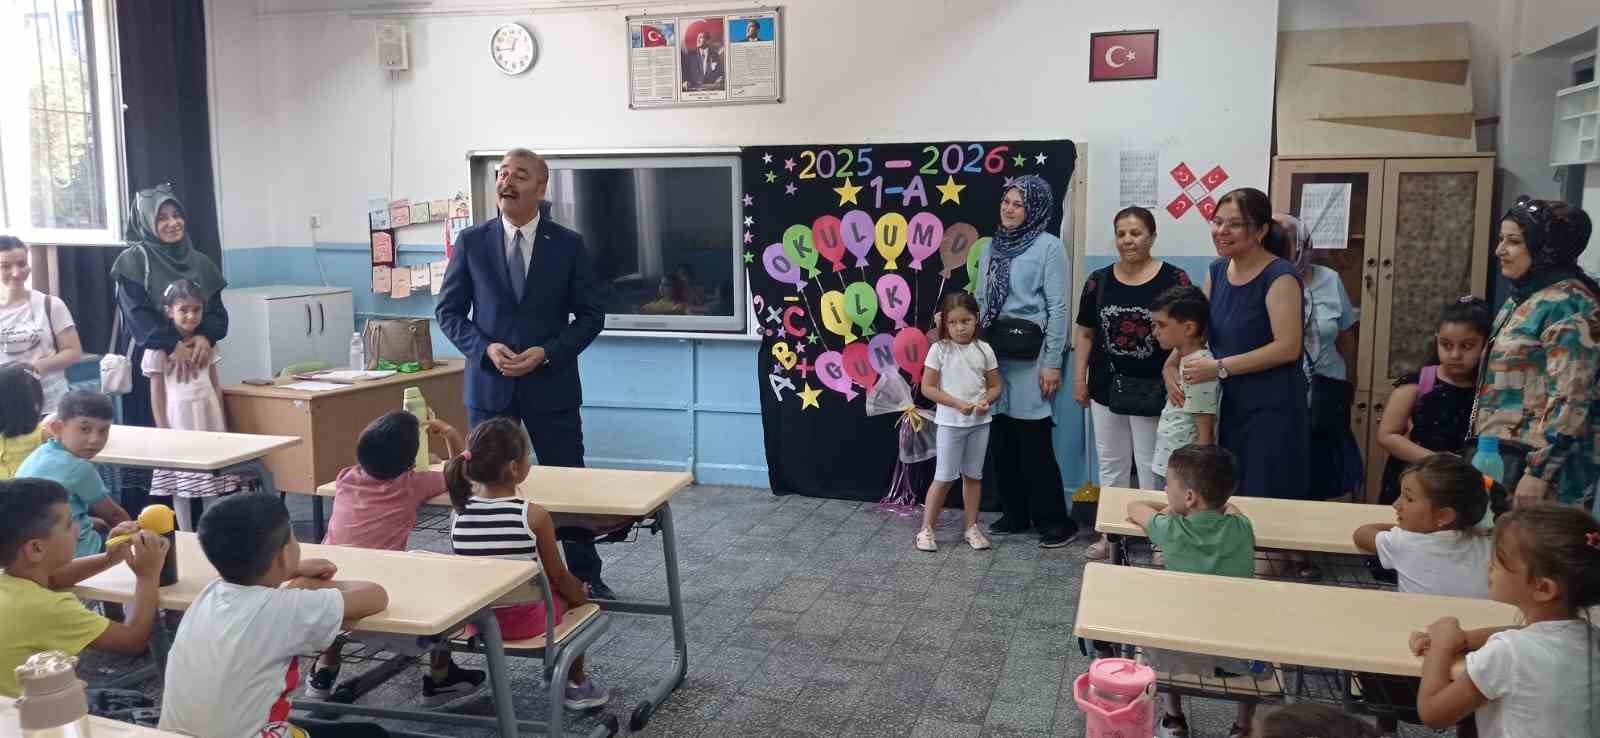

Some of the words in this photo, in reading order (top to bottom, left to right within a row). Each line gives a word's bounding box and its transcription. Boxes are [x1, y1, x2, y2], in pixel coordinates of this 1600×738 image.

[799, 147, 873, 179] 2025
[919, 144, 1009, 176] 2026
[870, 176, 929, 208] 1-A
[772, 222, 980, 274] OKULUMD
